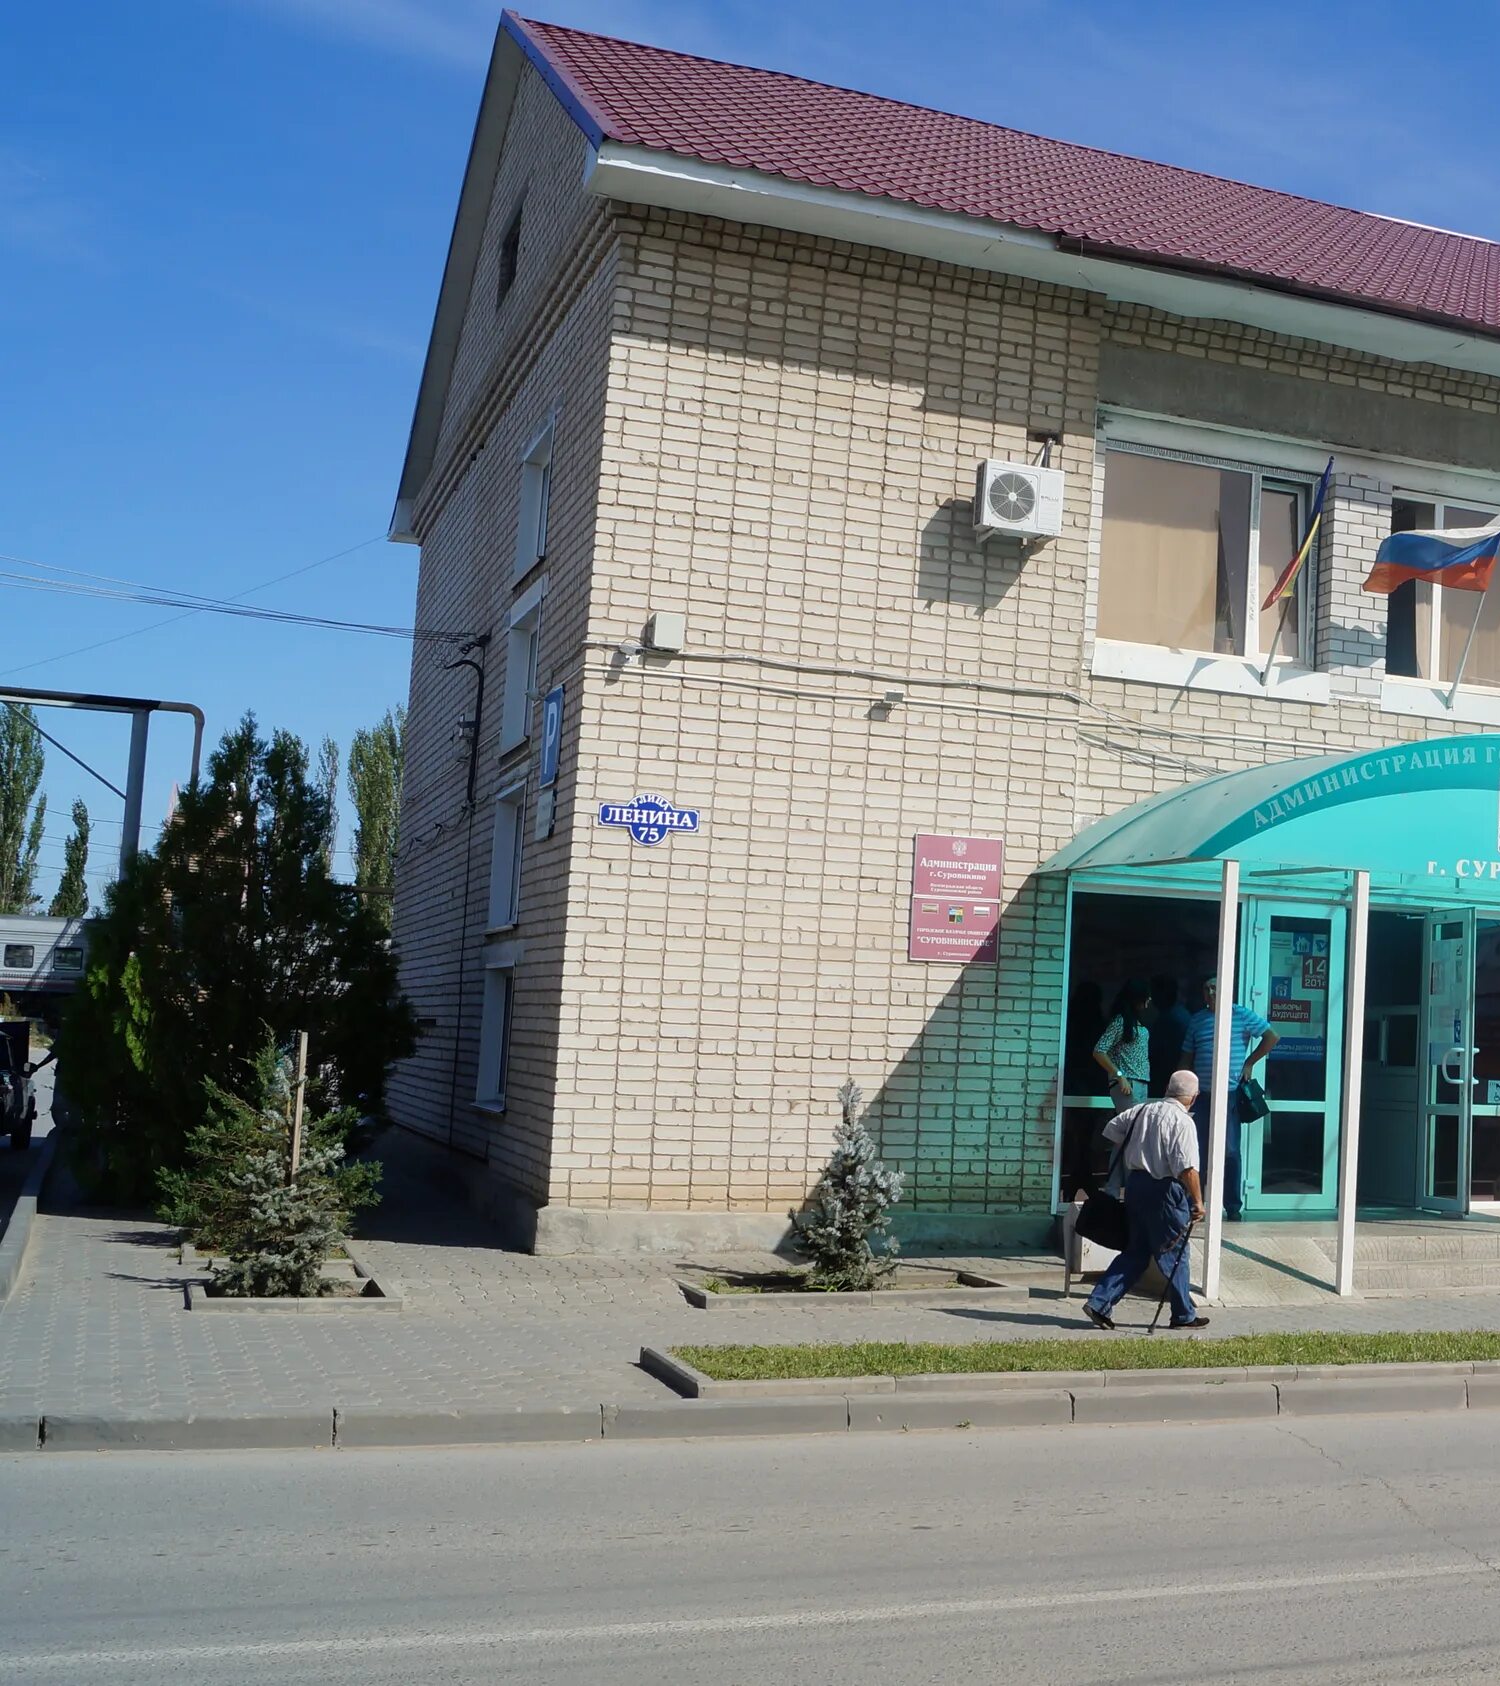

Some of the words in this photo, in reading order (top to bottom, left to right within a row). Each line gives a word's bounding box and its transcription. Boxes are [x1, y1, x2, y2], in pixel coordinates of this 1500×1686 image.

[1253, 747, 1476, 828] АДМИНИСТРАЦИЯ
[631, 794, 670, 811] УЛИЦА
[605, 807, 693, 827] ЛЕНИНА
[638, 827, 659, 842] 75
[920, 857, 997, 872] Администрация
[1427, 860, 1446, 875] г.
[1272, 1011, 1309, 1019] БУДУЩЕГО
